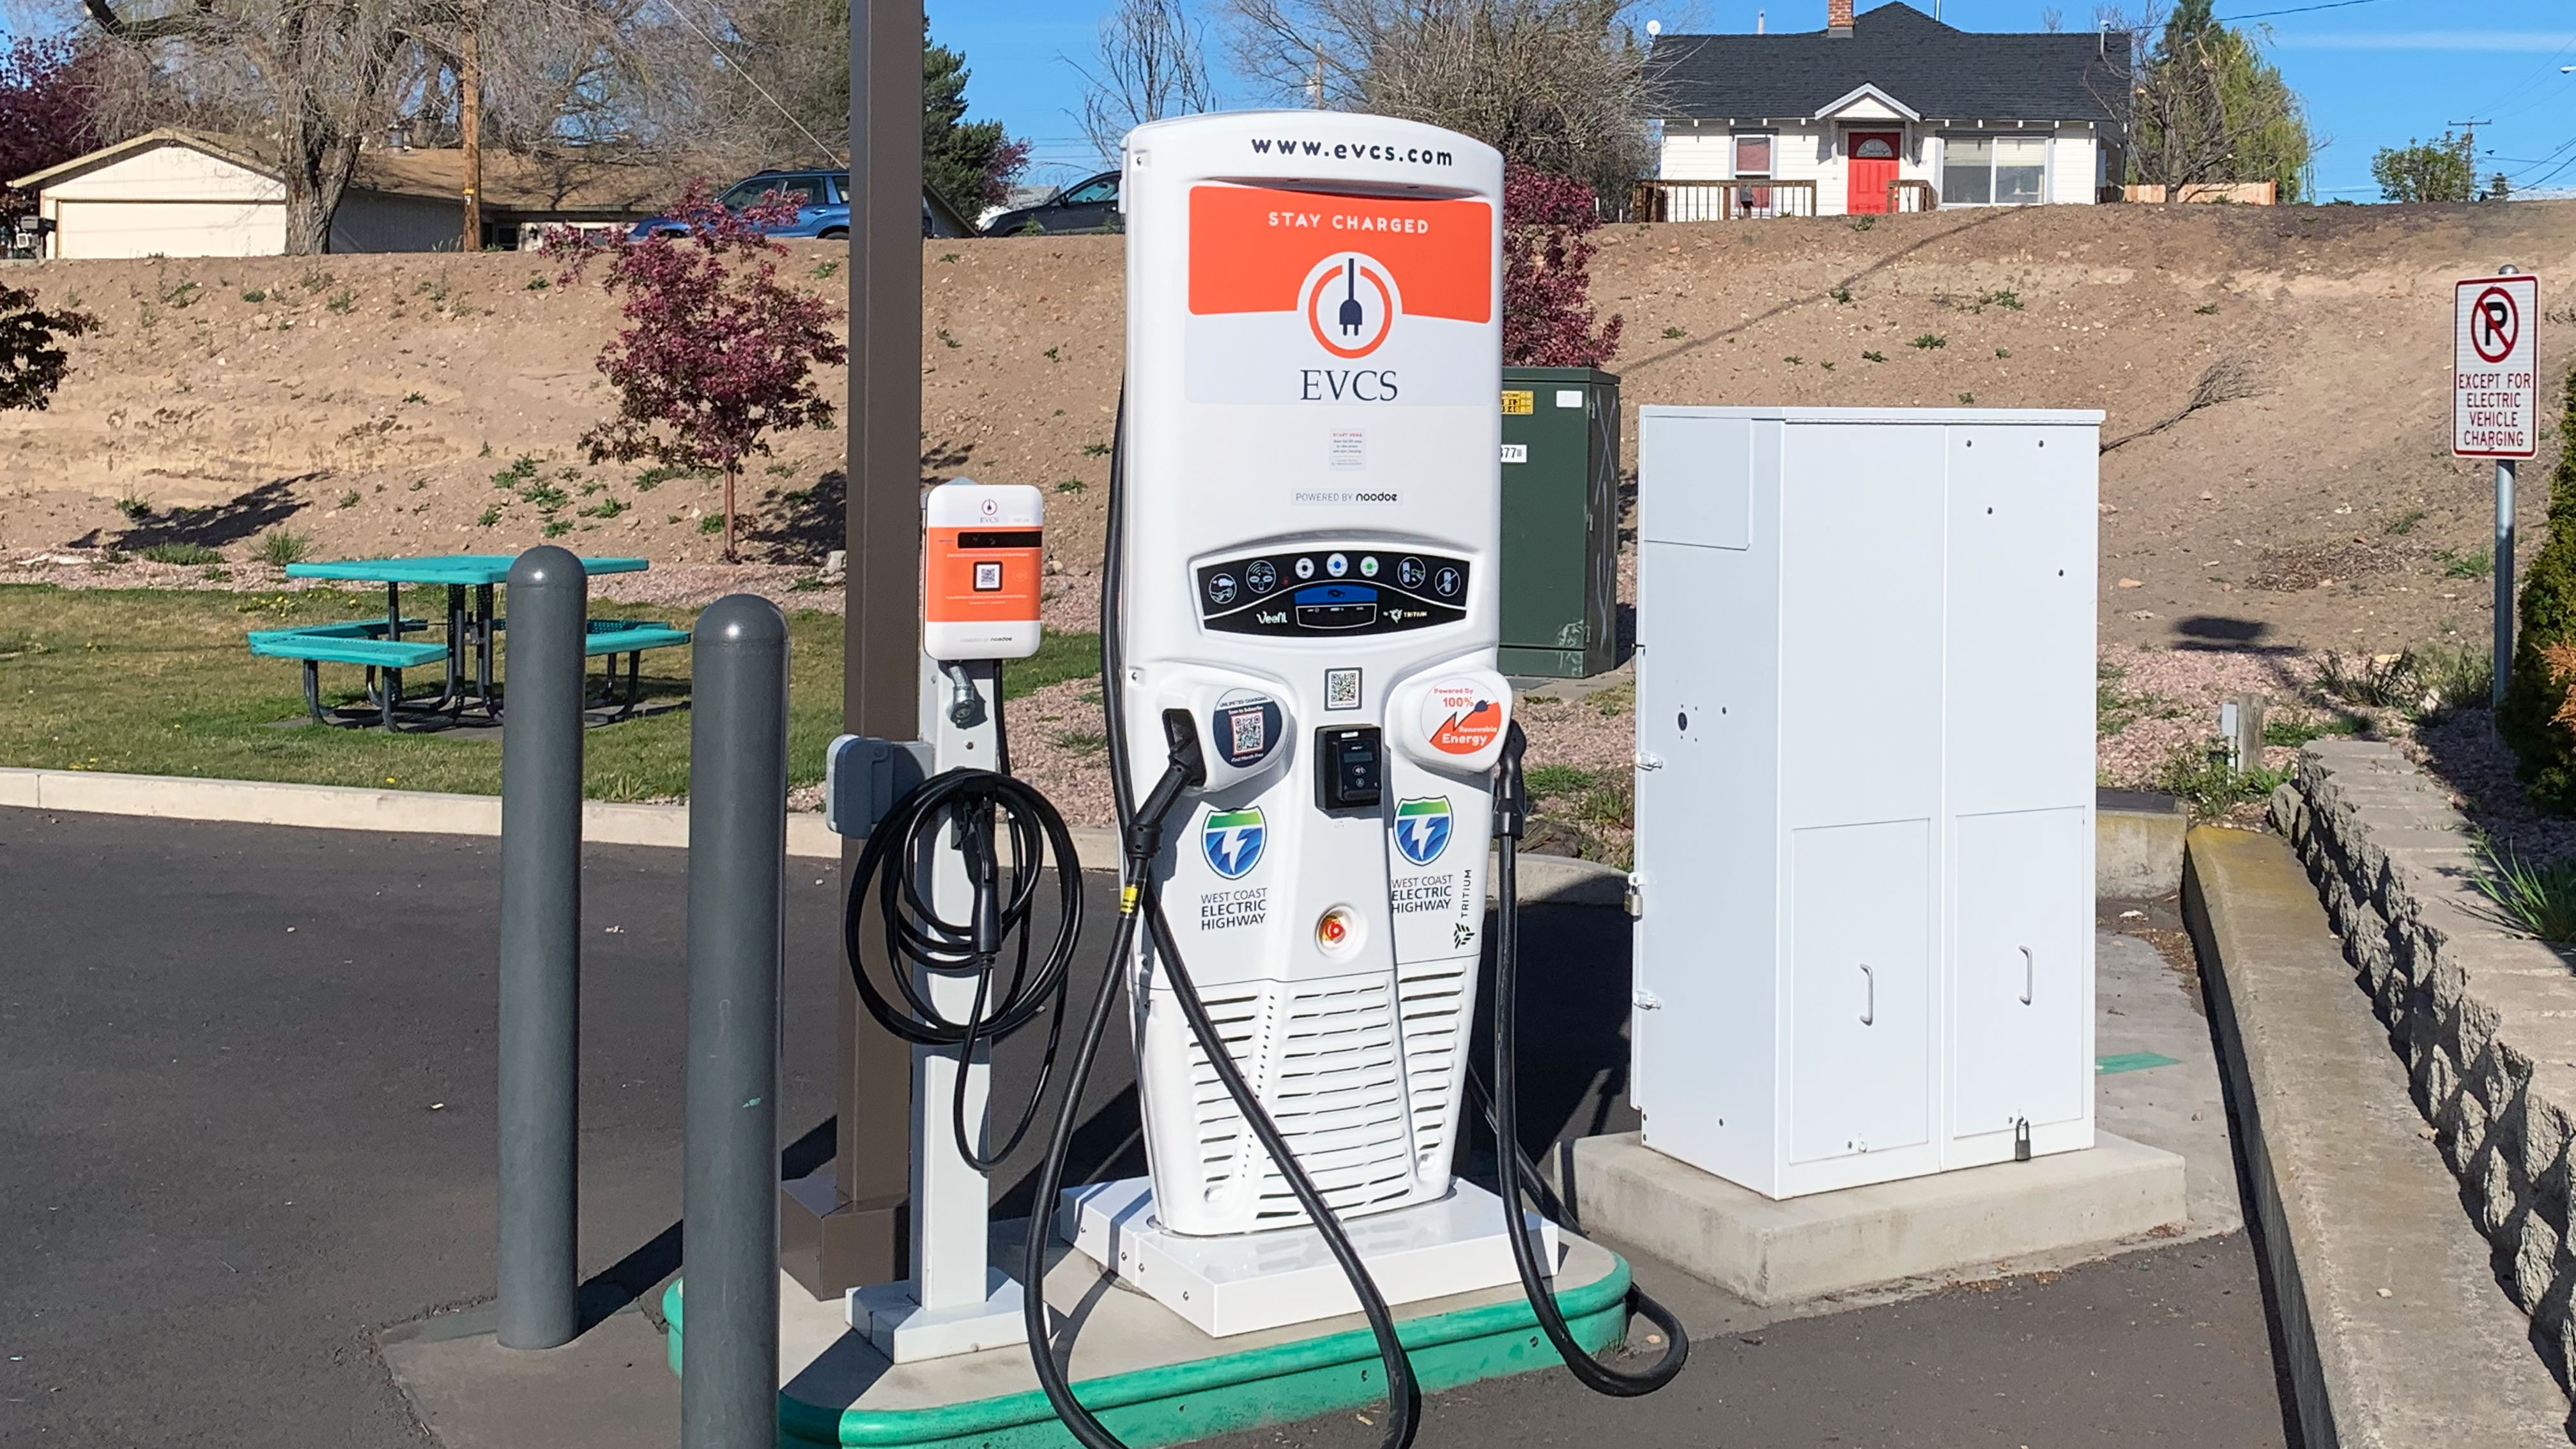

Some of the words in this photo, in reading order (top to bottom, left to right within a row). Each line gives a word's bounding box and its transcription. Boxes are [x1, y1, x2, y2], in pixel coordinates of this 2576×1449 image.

[1252, 138, 1453, 166] www.evcs.com
[1268, 211, 1321, 227] STAY
[1332, 215, 1429, 234] CHARGED
[1300, 370, 1399, 402] EVCS
[2459, 373, 2501, 389] EXCEPT
[2508, 373, 2531, 388] FOR
[2467, 392, 2521, 408] ELECTRIC
[2470, 411, 2518, 427] VEHICLE
[2464, 431, 2524, 447] CHARGING
[1296, 493, 1339, 502] POWERED
[1342, 493, 1353, 502] BY
[1356, 491, 1397, 502] noodoe
[1443, 696, 1474, 707] 100%
[1442, 733, 1487, 746] Energy
[1392, 878, 1419, 889] WEST
[1422, 875, 1453, 886] COAST
[1201, 892, 1230, 904] WEST
[1234, 887, 1268, 901] COAST
[1392, 885, 1452, 901] ELECTRIC
[1460, 870, 1471, 919] TRITIUM
[1202, 899, 1266, 917] ELECTRIC
[1392, 898, 1452, 914] HIGHWAY
[1202, 913, 1266, 931] HIGHWAY
